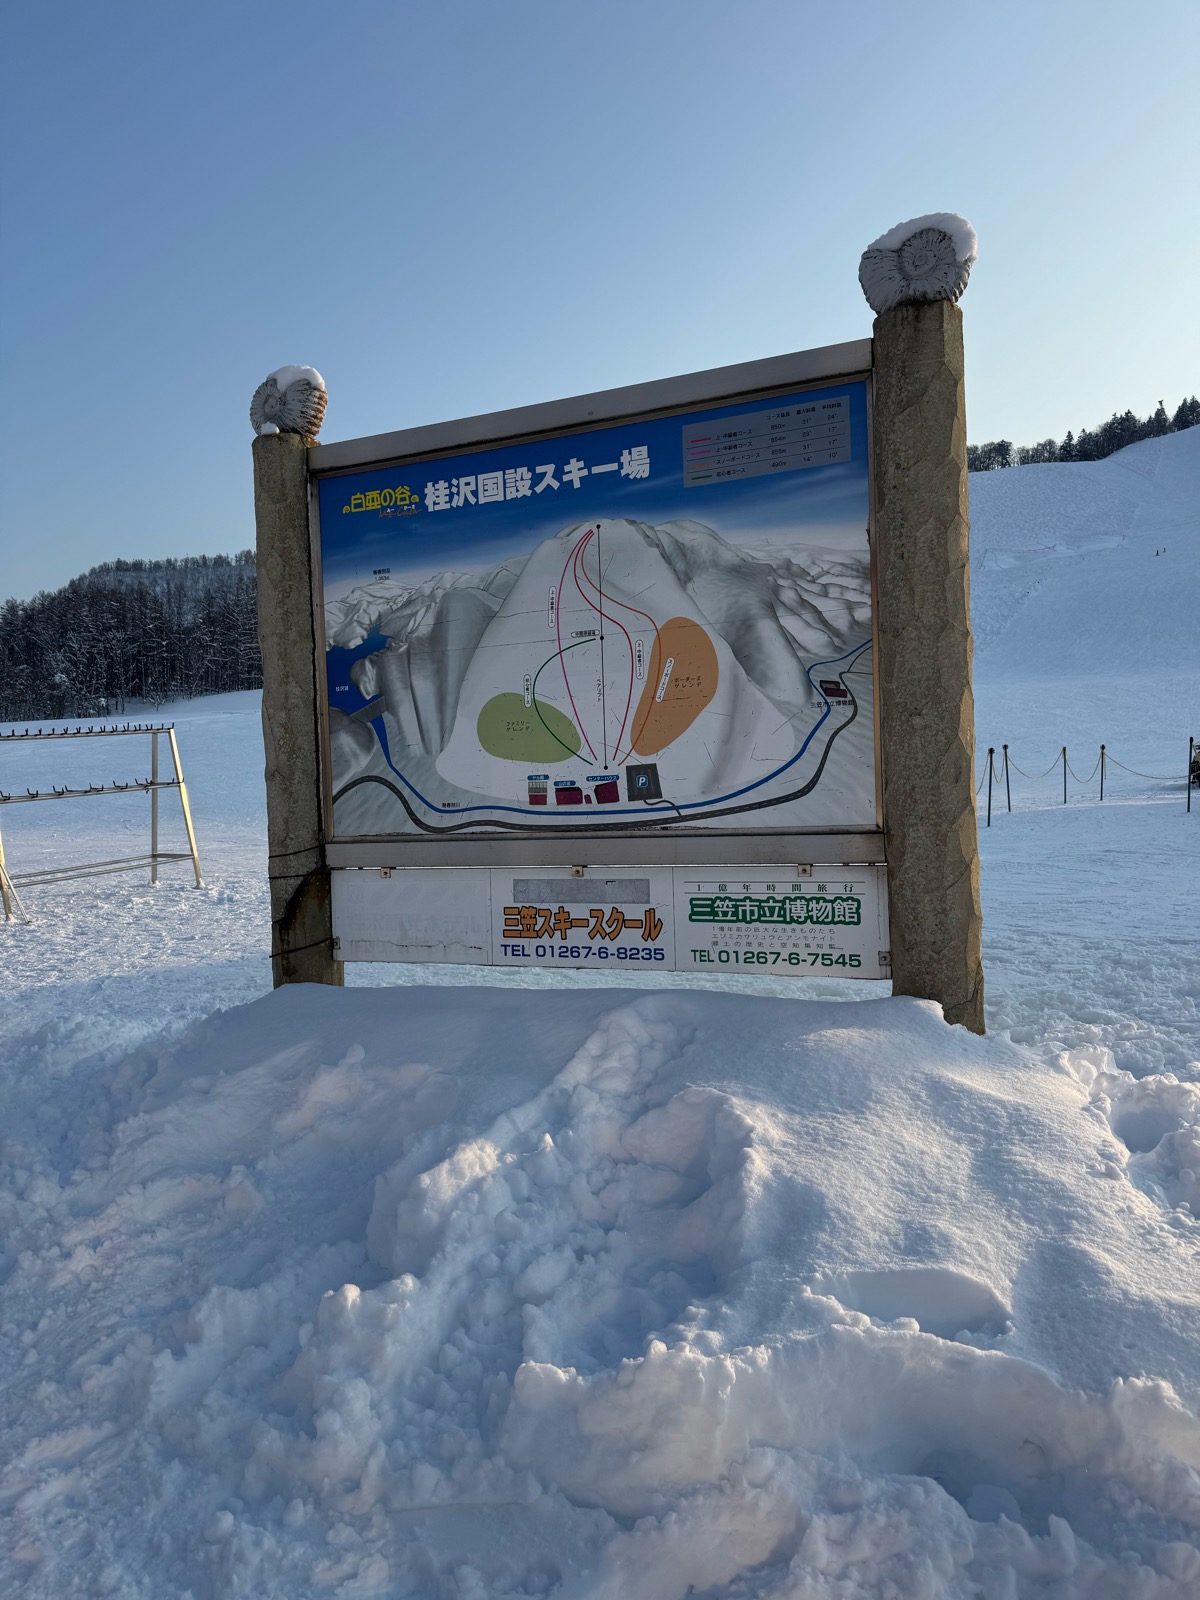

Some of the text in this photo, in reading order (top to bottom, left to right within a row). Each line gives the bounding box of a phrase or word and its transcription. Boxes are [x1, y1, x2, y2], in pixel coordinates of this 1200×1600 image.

[424, 446, 650, 512] 桂沢国設スキー場
[351, 485, 411, 513] 白亜の谷
[503, 906, 663, 942] 三笠スキースクール
[690, 897, 860, 924] 三笠市立博物館
[501, 944, 665, 961] TEL 01267-6-8235
[691, 949, 862, 967] TEL 01267-6-7545
